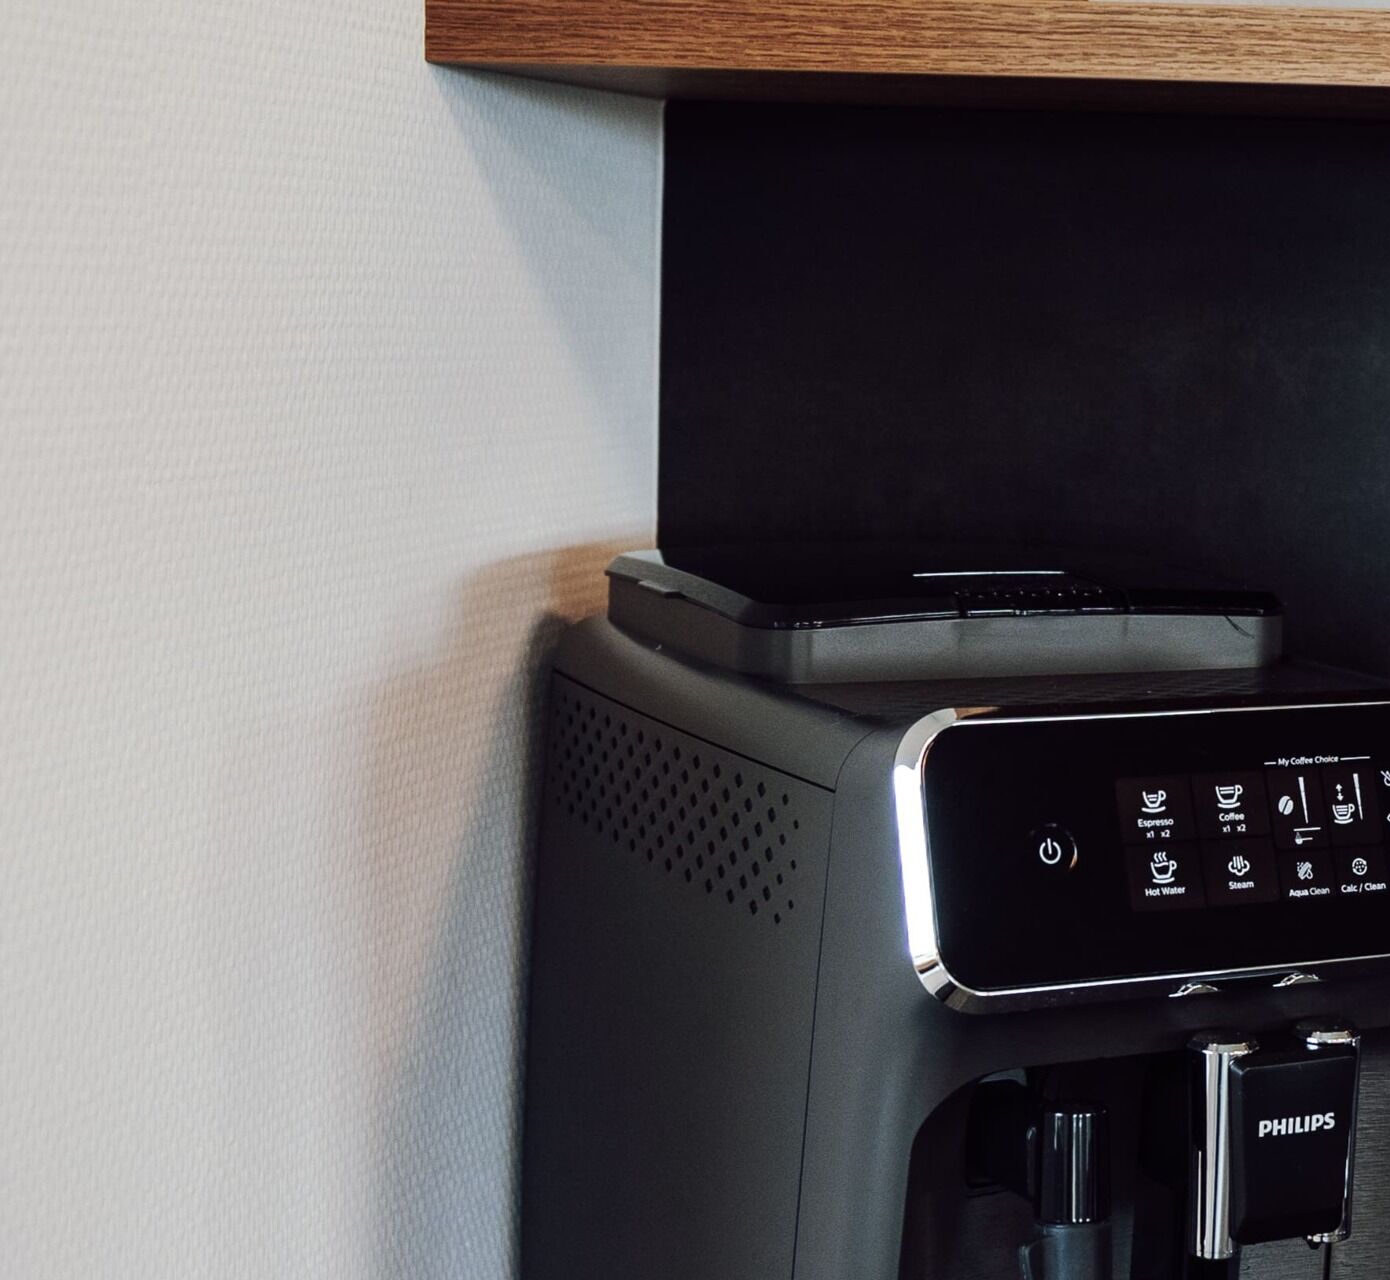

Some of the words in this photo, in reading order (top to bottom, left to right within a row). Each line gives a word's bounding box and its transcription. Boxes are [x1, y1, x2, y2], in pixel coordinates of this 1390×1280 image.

[1277, 757, 1290, 768] My
[1290, 756, 1314, 766] Coffee
[1314, 755, 1339, 764] Choice
[1218, 812, 1245, 822] Coffee
[1137, 818, 1174, 828] Espresso
[1222, 824, 1231, 833] x1
[1236, 823, 1247, 832] x2
[1146, 830, 1155, 839] x1
[1160, 829, 1171, 838] x2
[1228, 880, 1255, 890] Steam
[1340, 884, 1358, 894] Calc
[1364, 882, 1387, 892] Clean
[1144, 887, 1160, 897] Hot
[1161, 886, 1186, 896] Water
[1288, 888, 1309, 898] Aqua
[1309, 887, 1331, 896] Clean
[1258, 1112, 1336, 1138] PHILIPS
